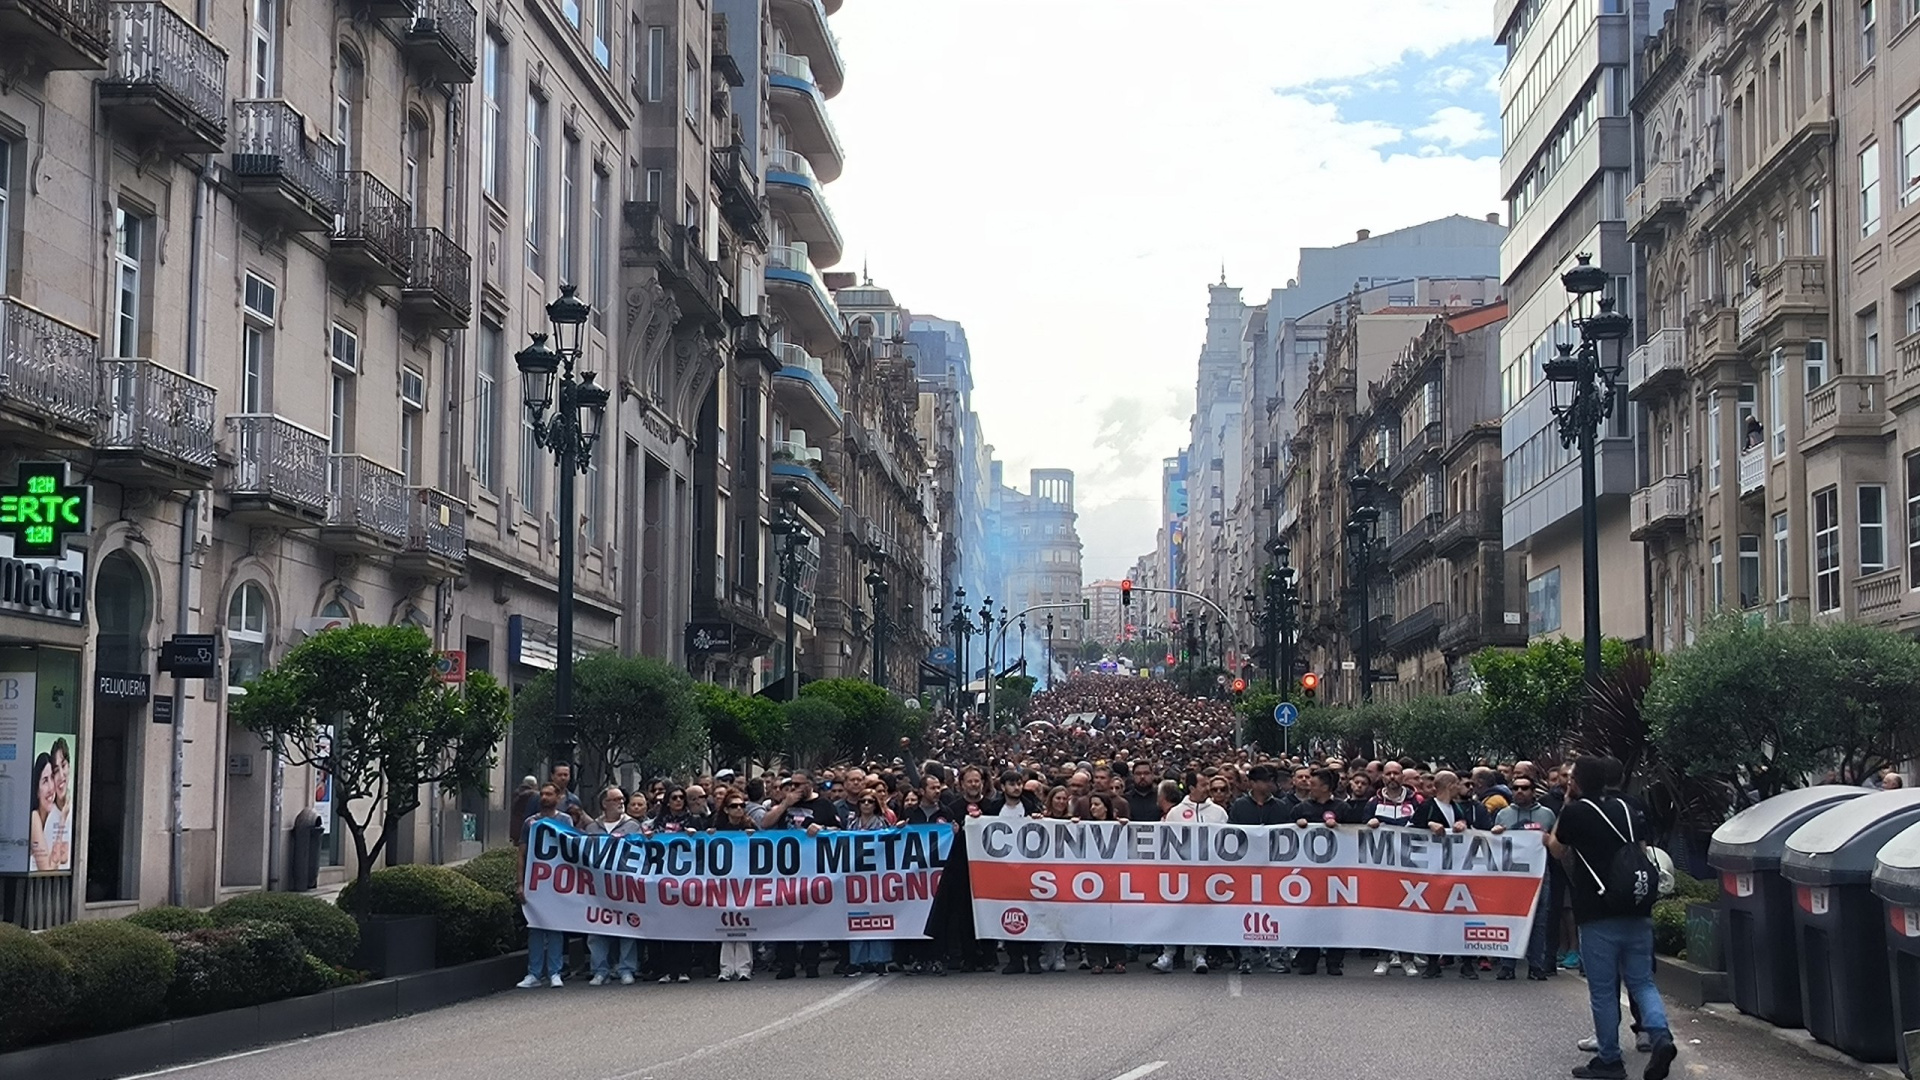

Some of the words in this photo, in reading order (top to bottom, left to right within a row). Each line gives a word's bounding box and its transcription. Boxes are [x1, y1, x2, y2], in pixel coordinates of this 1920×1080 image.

[28, 476, 55, 493] 12H
[25, 526, 53, 543] 12H
[100, 676, 147, 698] PELUQUERÍA
[534, 823, 734, 876] COMERCIO
[749, 836, 801, 876] DO
[815, 831, 949, 874] METAL
[981, 822, 1249, 861] CONVENIO
[1268, 827, 1338, 863] DO
[1358, 829, 1530, 872] METAL
[529, 862, 596, 896] POR
[604, 873, 646, 904] UN
[657, 876, 833, 907] CONVENIO
[1029, 869, 1358, 904] SOLUCIÓN
[1398, 879, 1478, 912] XA
[587, 906, 623, 925] UGT
[721, 911, 750, 926] CIG
[850, 918, 891, 928] CCOO
[1004, 911, 1024, 923] UGT
[1243, 912, 1278, 934] CIG
[1467, 929, 1507, 940] CCOO
[1464, 942, 1509, 951] industria
